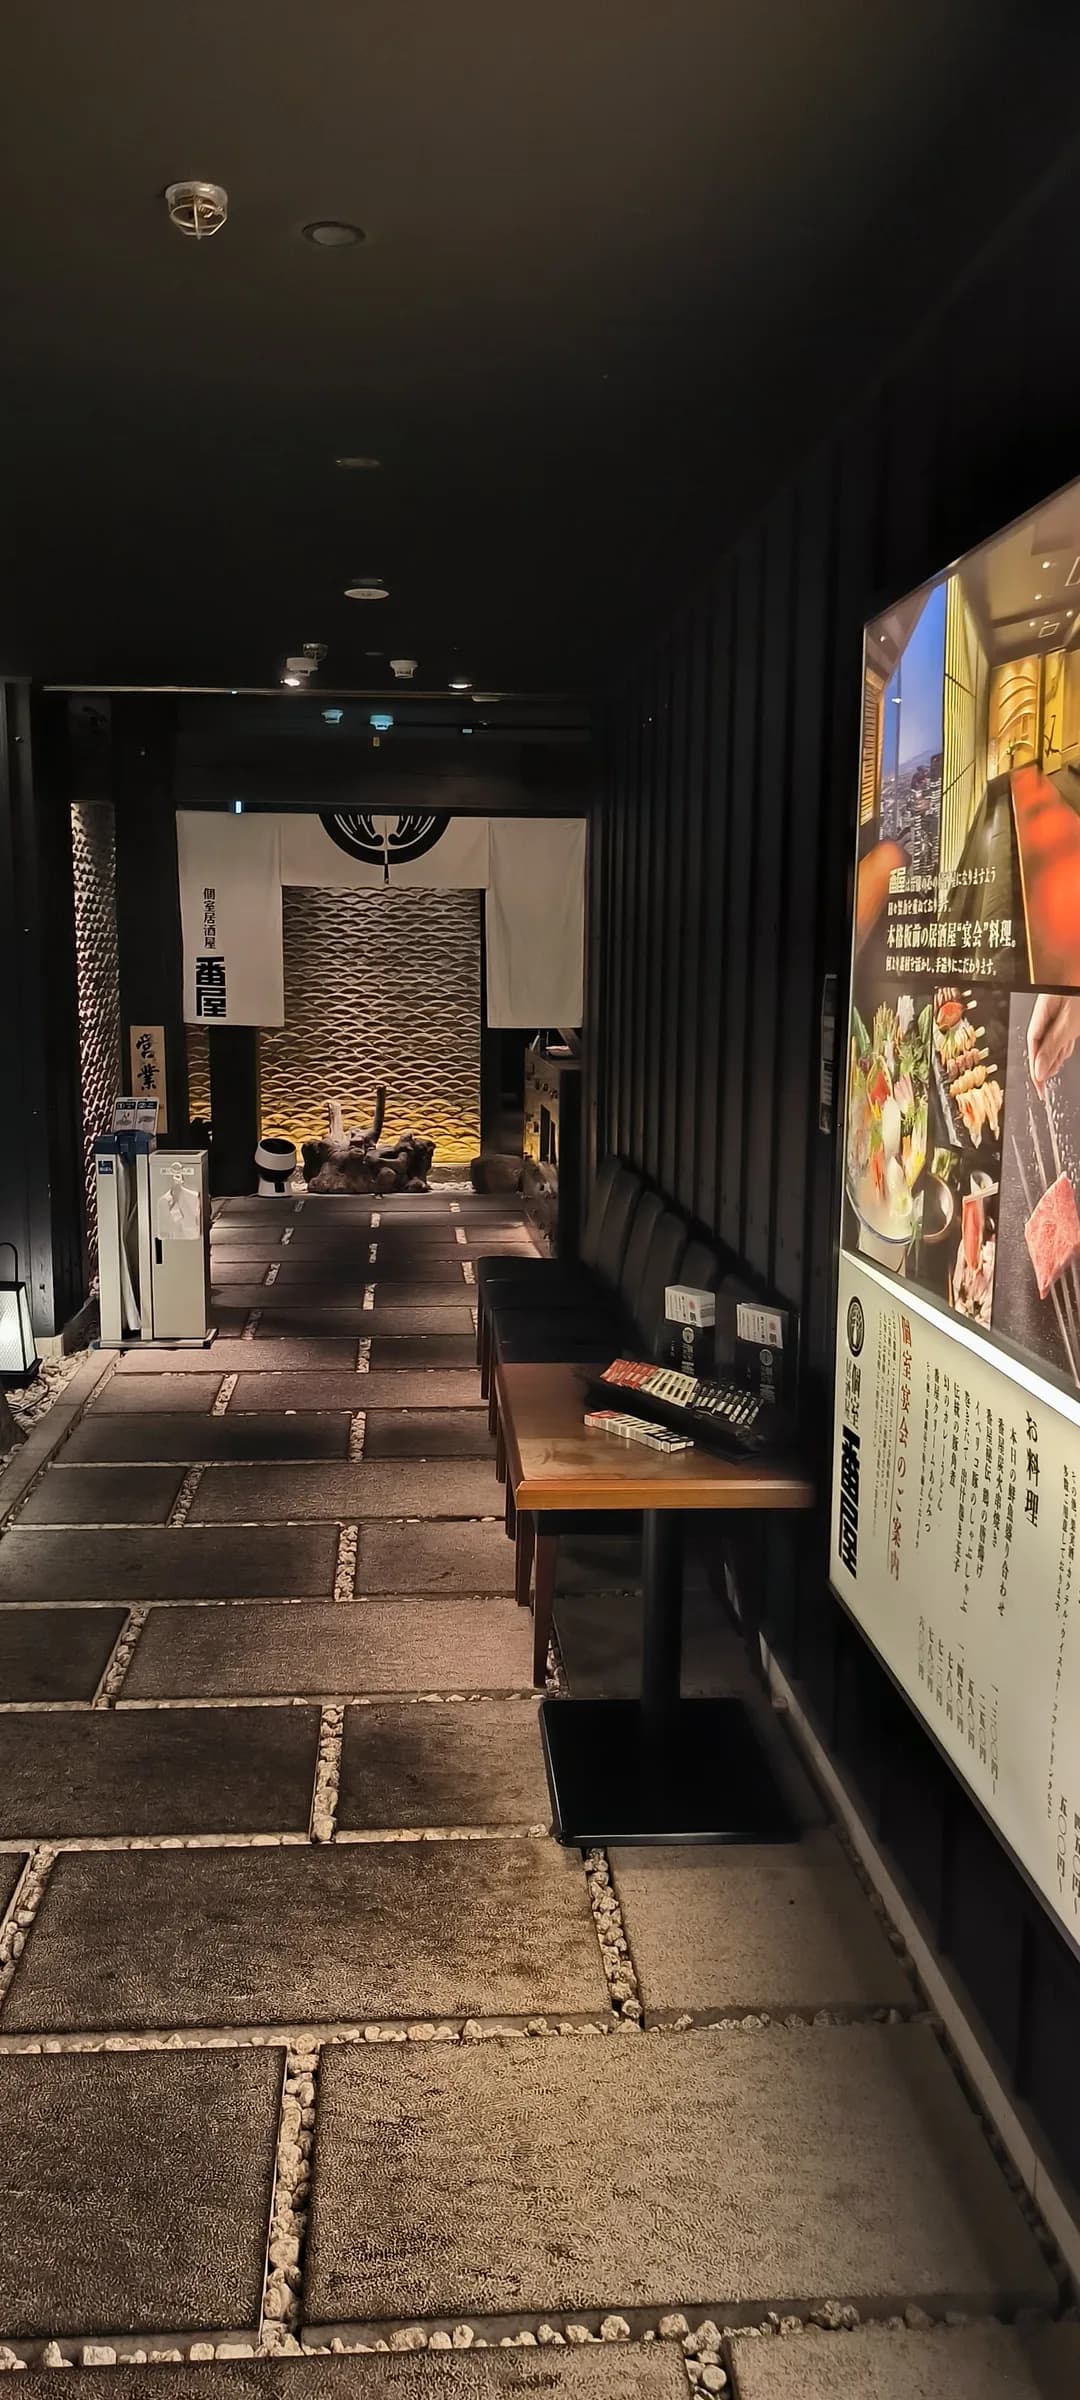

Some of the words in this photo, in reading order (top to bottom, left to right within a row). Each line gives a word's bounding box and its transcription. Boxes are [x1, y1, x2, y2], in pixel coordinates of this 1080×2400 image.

[203, 887, 217, 950] 個室居酒屋
[195, 956, 227, 1018] 番屋
[136, 1033, 160, 1096] 営業
[851, 1362, 862, 1430] 個室
[890, 1314, 913, 1581] 個室宴会のご案内
[1025, 1409, 1041, 1529] お料理
[839, 1424, 861, 1579] 番屋
[997, 1427, 1018, 1616] 本日の鮮魚盛り合わせ
